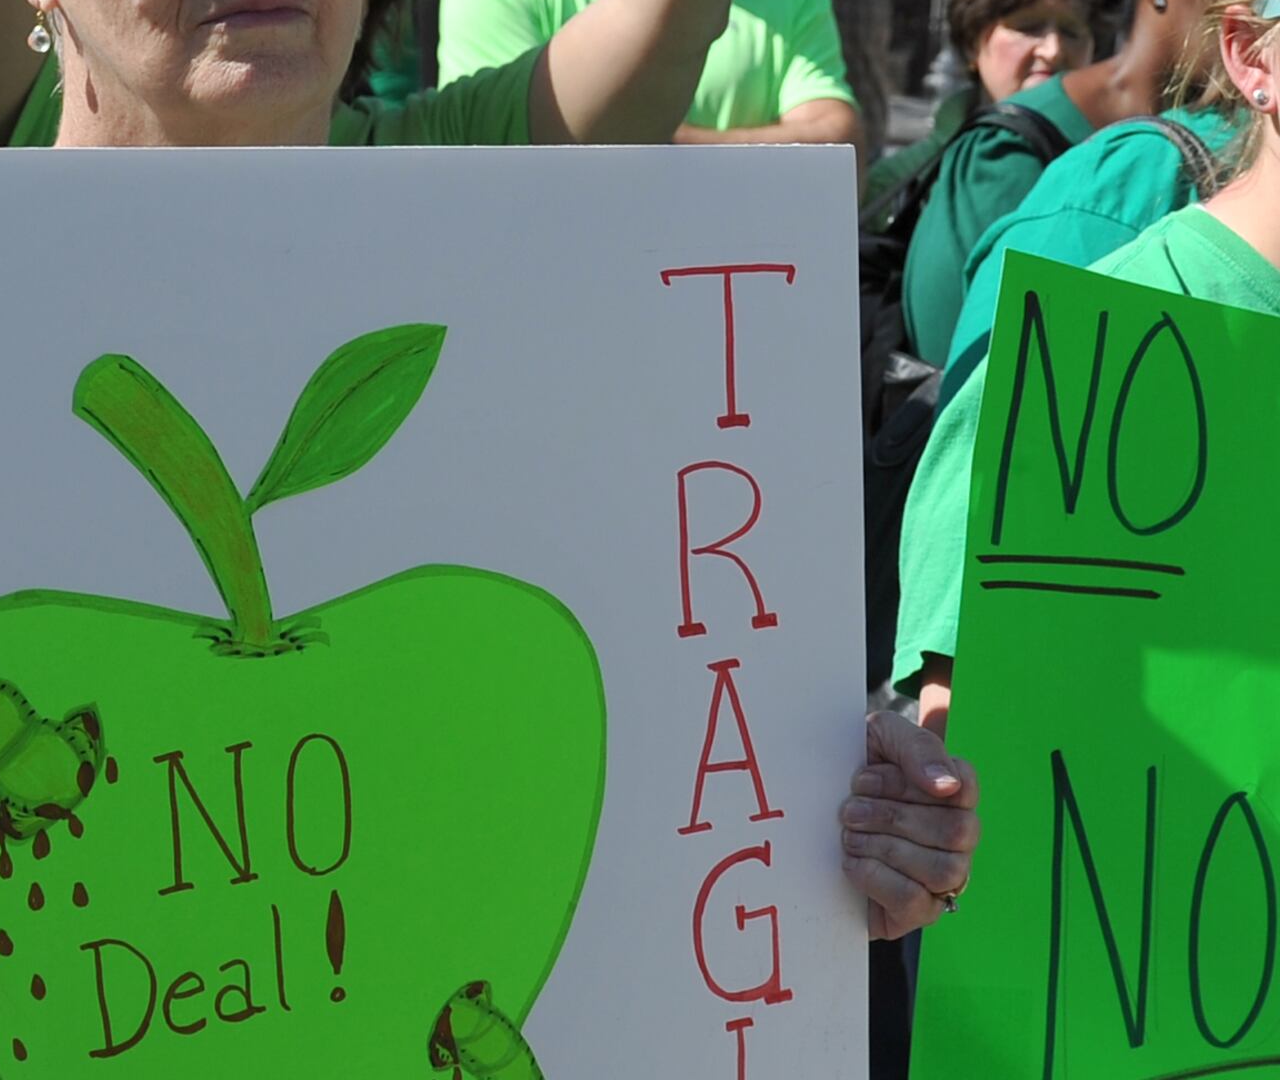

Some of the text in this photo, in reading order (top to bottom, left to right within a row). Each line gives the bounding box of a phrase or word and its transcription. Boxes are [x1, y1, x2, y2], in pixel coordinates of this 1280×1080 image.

[991, 291, 1208, 545] NO
[152, 733, 352, 895] NO
[1042, 750, 1277, 1080] NO
[80, 889, 347, 1059] Deal!
